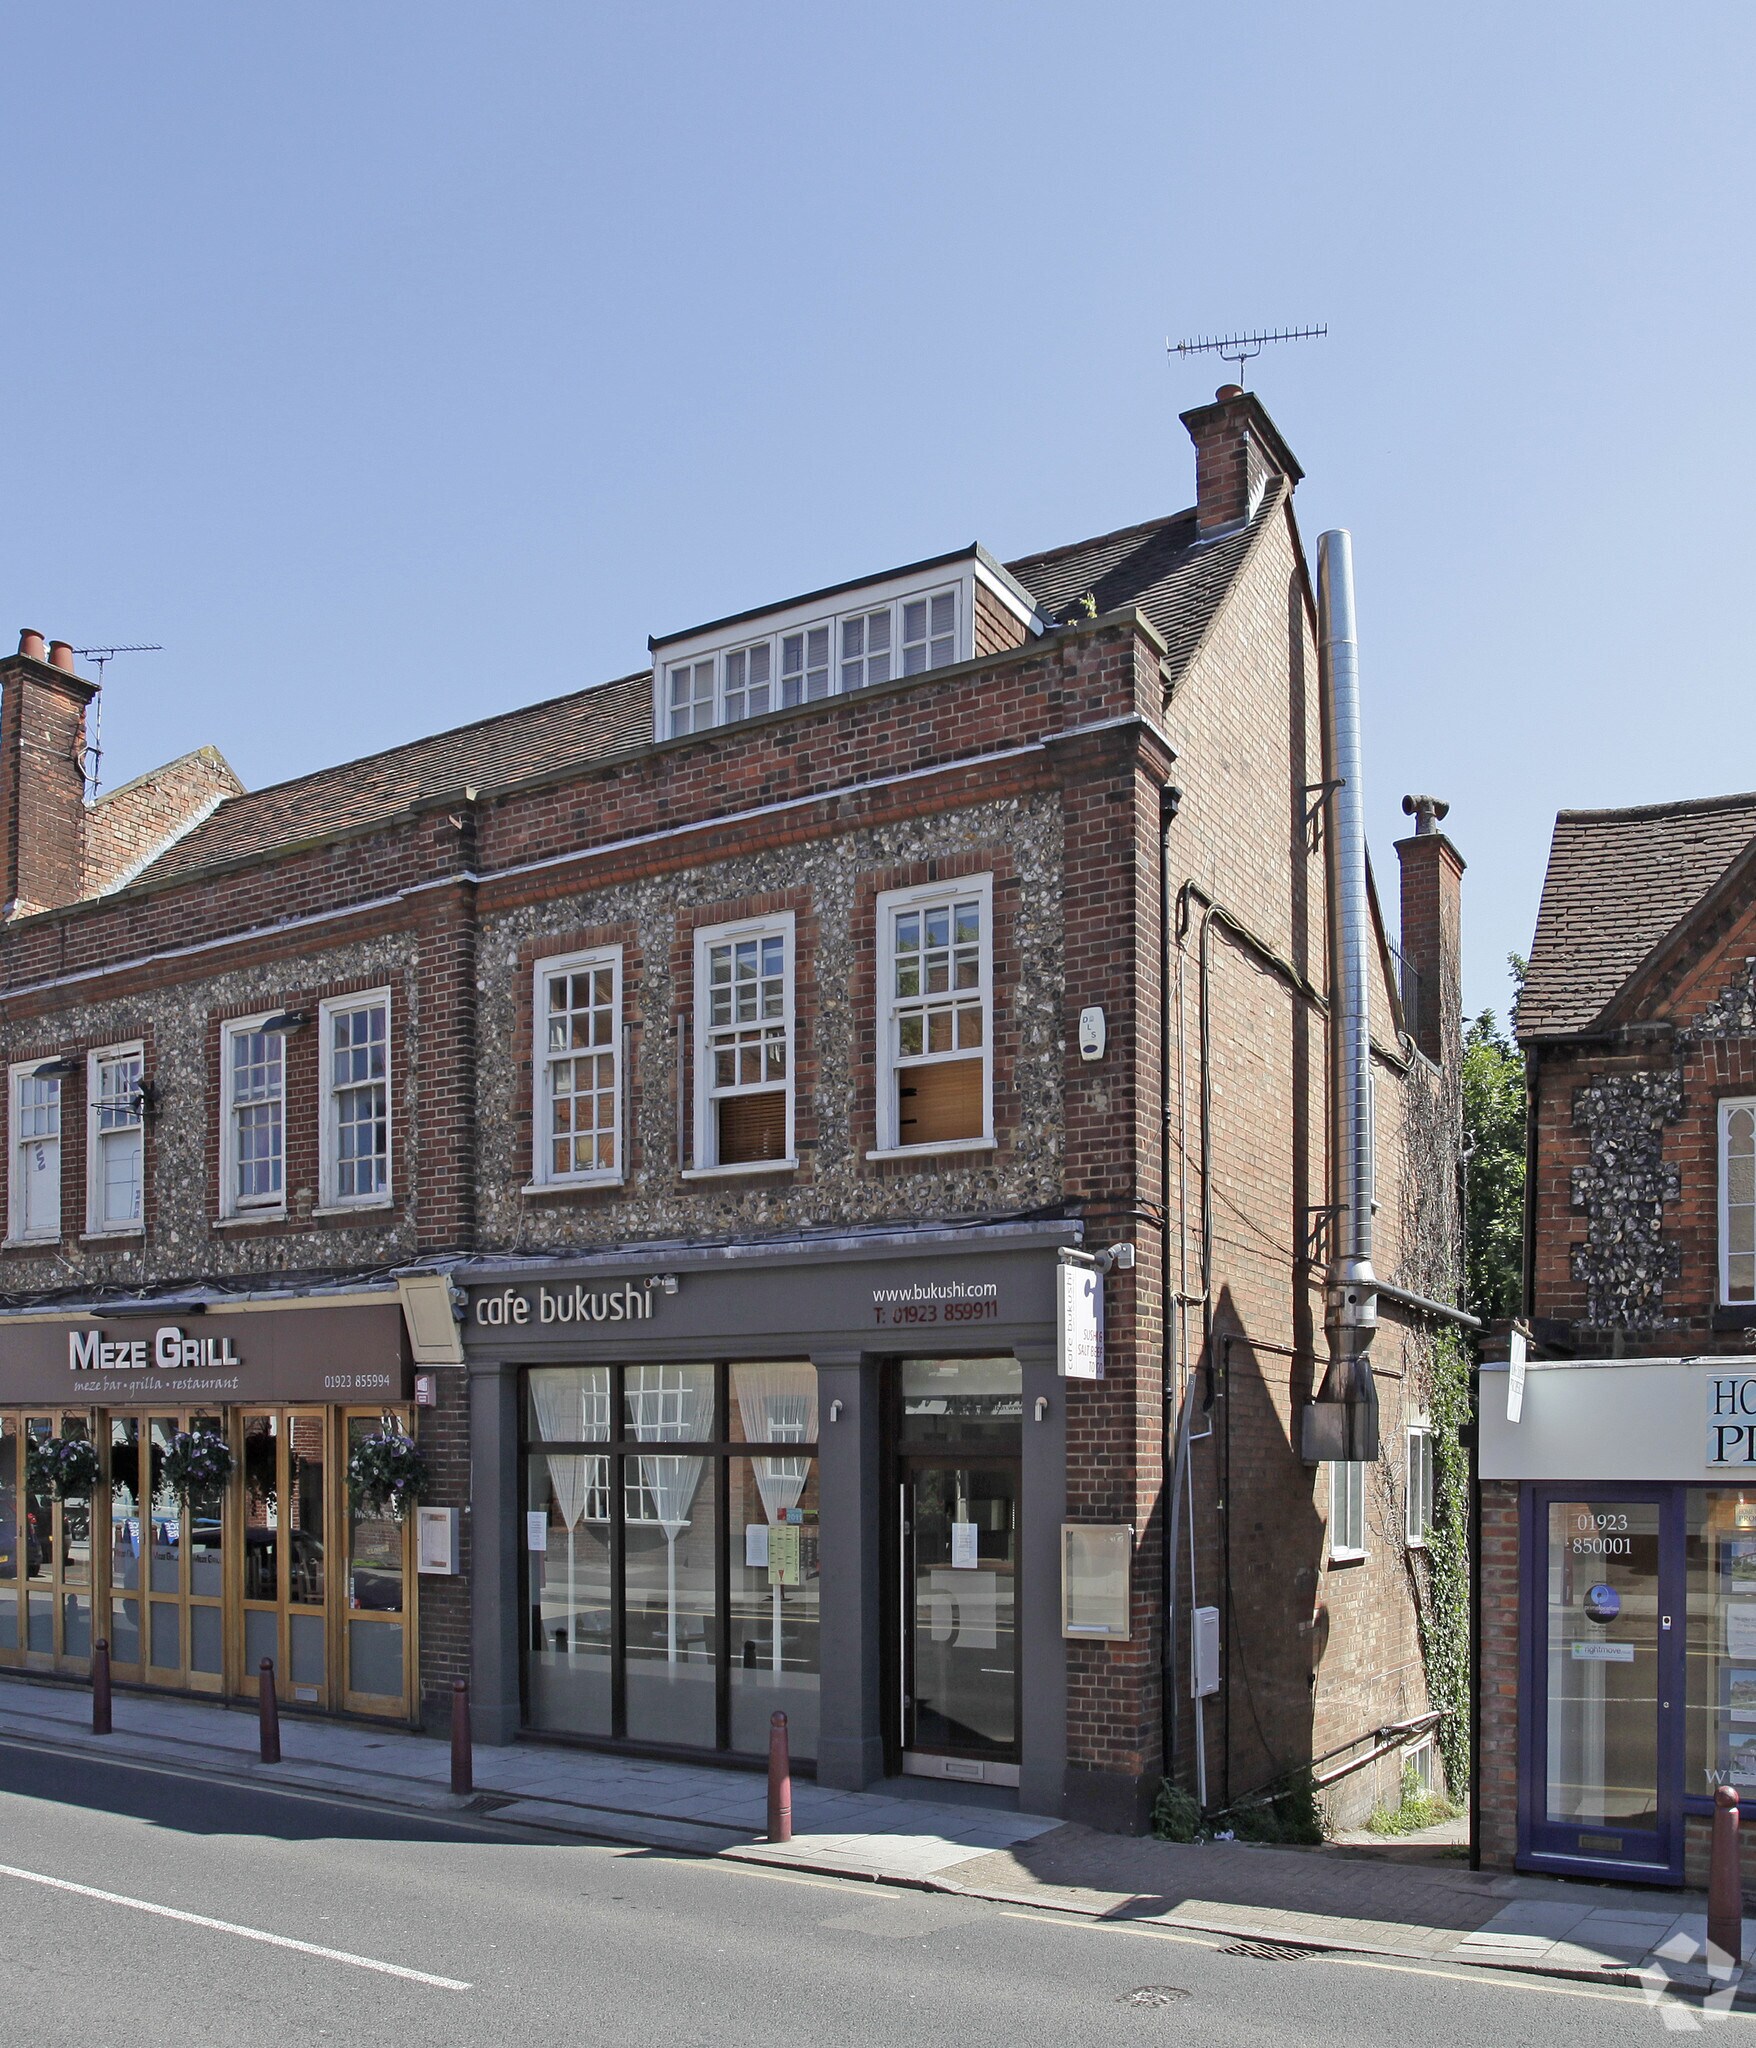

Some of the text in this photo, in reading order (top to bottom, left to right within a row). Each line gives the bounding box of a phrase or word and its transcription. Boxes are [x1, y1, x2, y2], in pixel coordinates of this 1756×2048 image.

[872, 1281, 997, 1301] www.bukushi.com
[476, 1282, 653, 1326] cafe bukushi
[873, 1299, 998, 1324] T: 01923 859911
[1066, 1272, 1074, 1370] cafe bukushi
[69, 1326, 241, 1370] MEZE GRILL
[1077, 1343, 1090, 1357] SALT
[74, 1375, 240, 1399] meze bar grilla restaurant
[324, 1374, 390, 1388] 01923 855994
[1577, 1514, 1628, 1531] 01923
[1572, 1537, 1632, 1555] 850001
